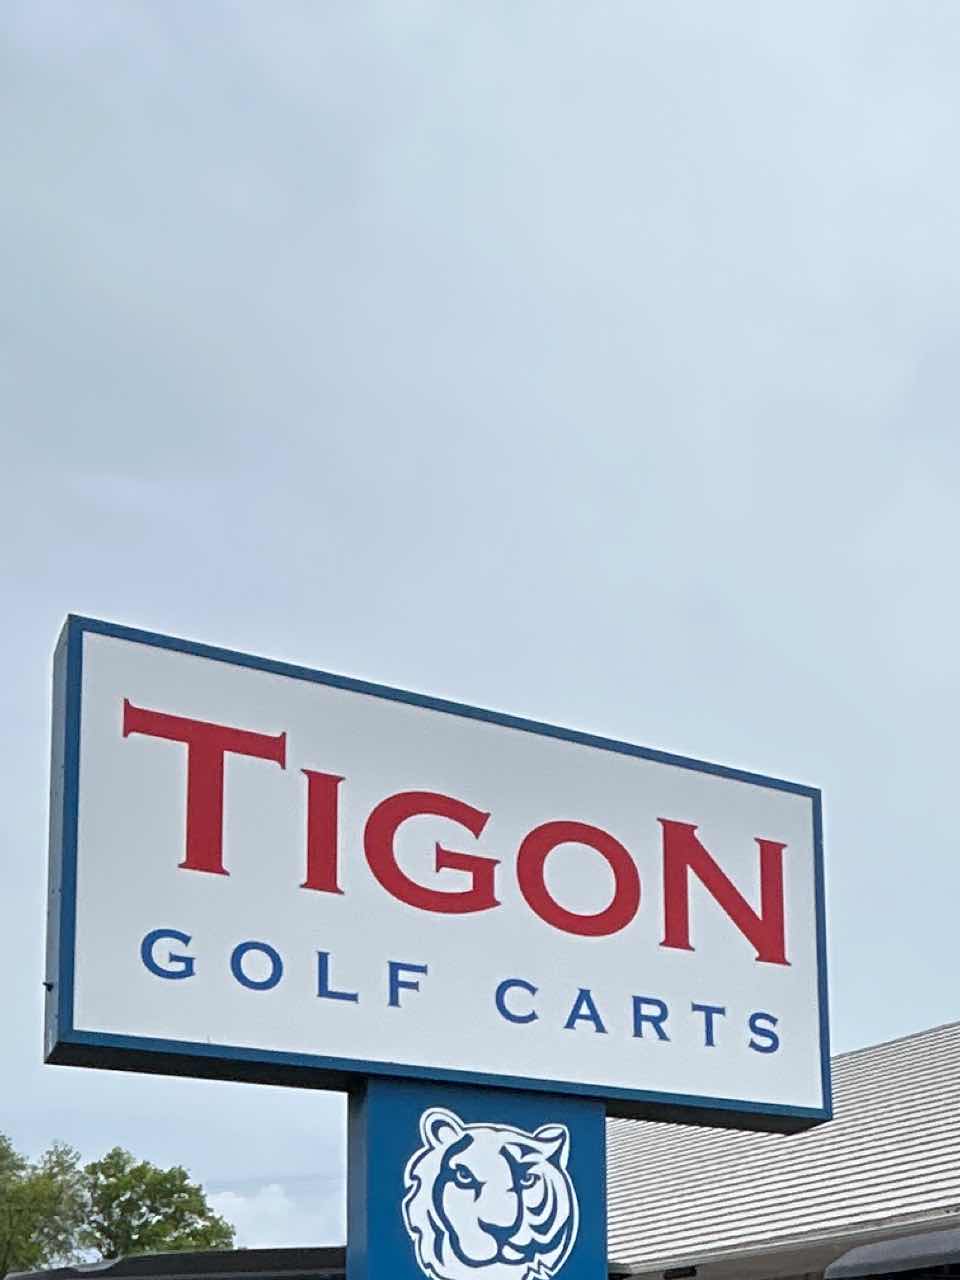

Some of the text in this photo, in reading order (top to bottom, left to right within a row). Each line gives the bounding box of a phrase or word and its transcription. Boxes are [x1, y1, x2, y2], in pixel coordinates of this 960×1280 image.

[123, 698, 791, 967] TIGON
[140, 927, 781, 1054] GOLF CARTS
